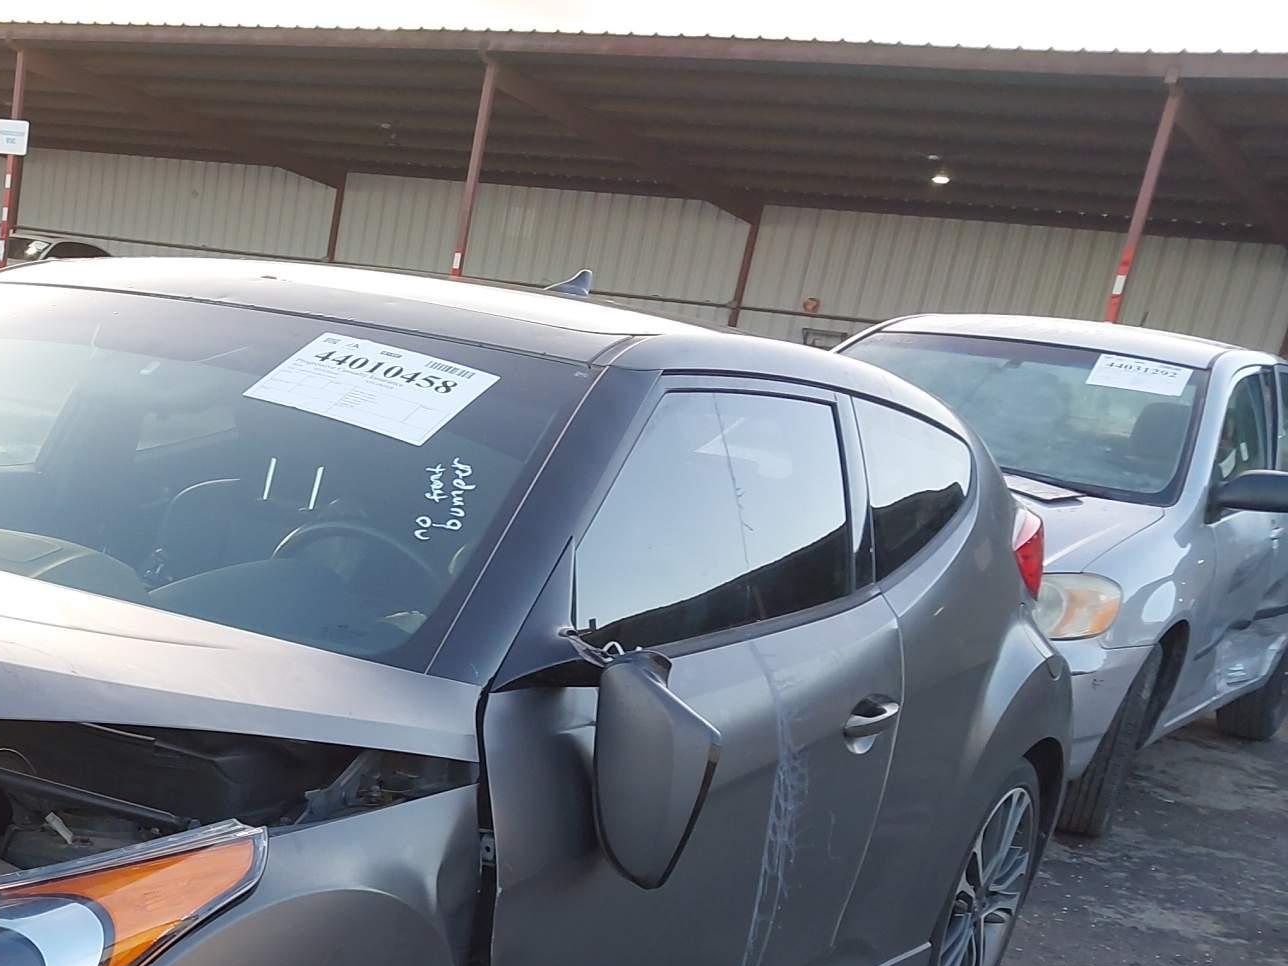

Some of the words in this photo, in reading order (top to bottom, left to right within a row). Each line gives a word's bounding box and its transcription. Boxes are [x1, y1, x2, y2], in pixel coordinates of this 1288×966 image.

[314, 350, 458, 394] 44010458
[413, 515, 432, 541] no
[424, 463, 449, 503] front
[431, 457, 477, 531] bumper
